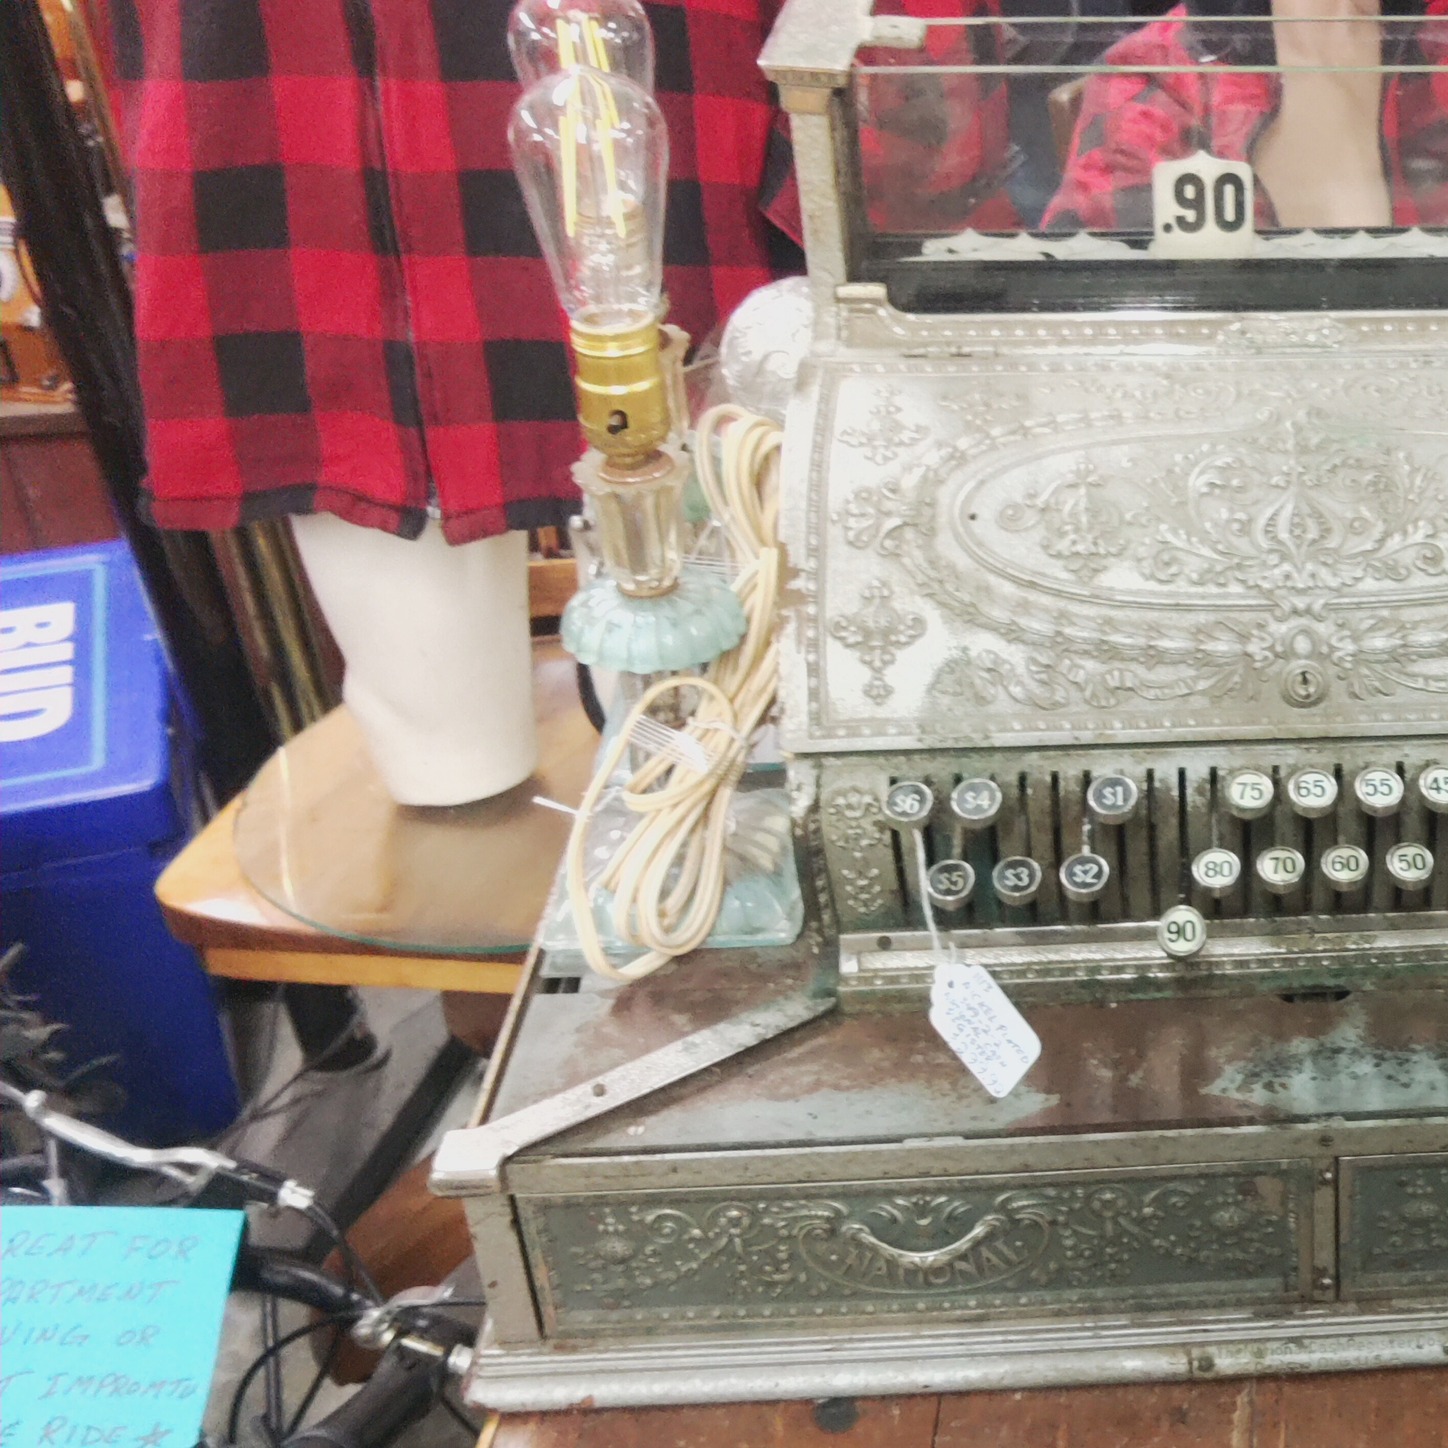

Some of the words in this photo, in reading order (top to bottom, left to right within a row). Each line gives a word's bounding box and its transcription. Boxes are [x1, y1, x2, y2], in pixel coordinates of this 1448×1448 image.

[1163, 172, 1245, 234] .90
[0, 601, 76, 743] BUD
[1235, 782, 1264, 801] 75
[1298, 780, 1326, 799] 65
[1364, 778, 1393, 797] 55
[1204, 860, 1233, 879] 80
[1269, 856, 1297, 875] 70
[1331, 854, 1360, 872] 60
[1398, 853, 1427, 872] 50
[1167, 920, 1195, 943] 90
[123, 1234, 201, 1263] FOR
[115, 1324, 162, 1347] OR
[37, 1414, 128, 1447] RIDE
